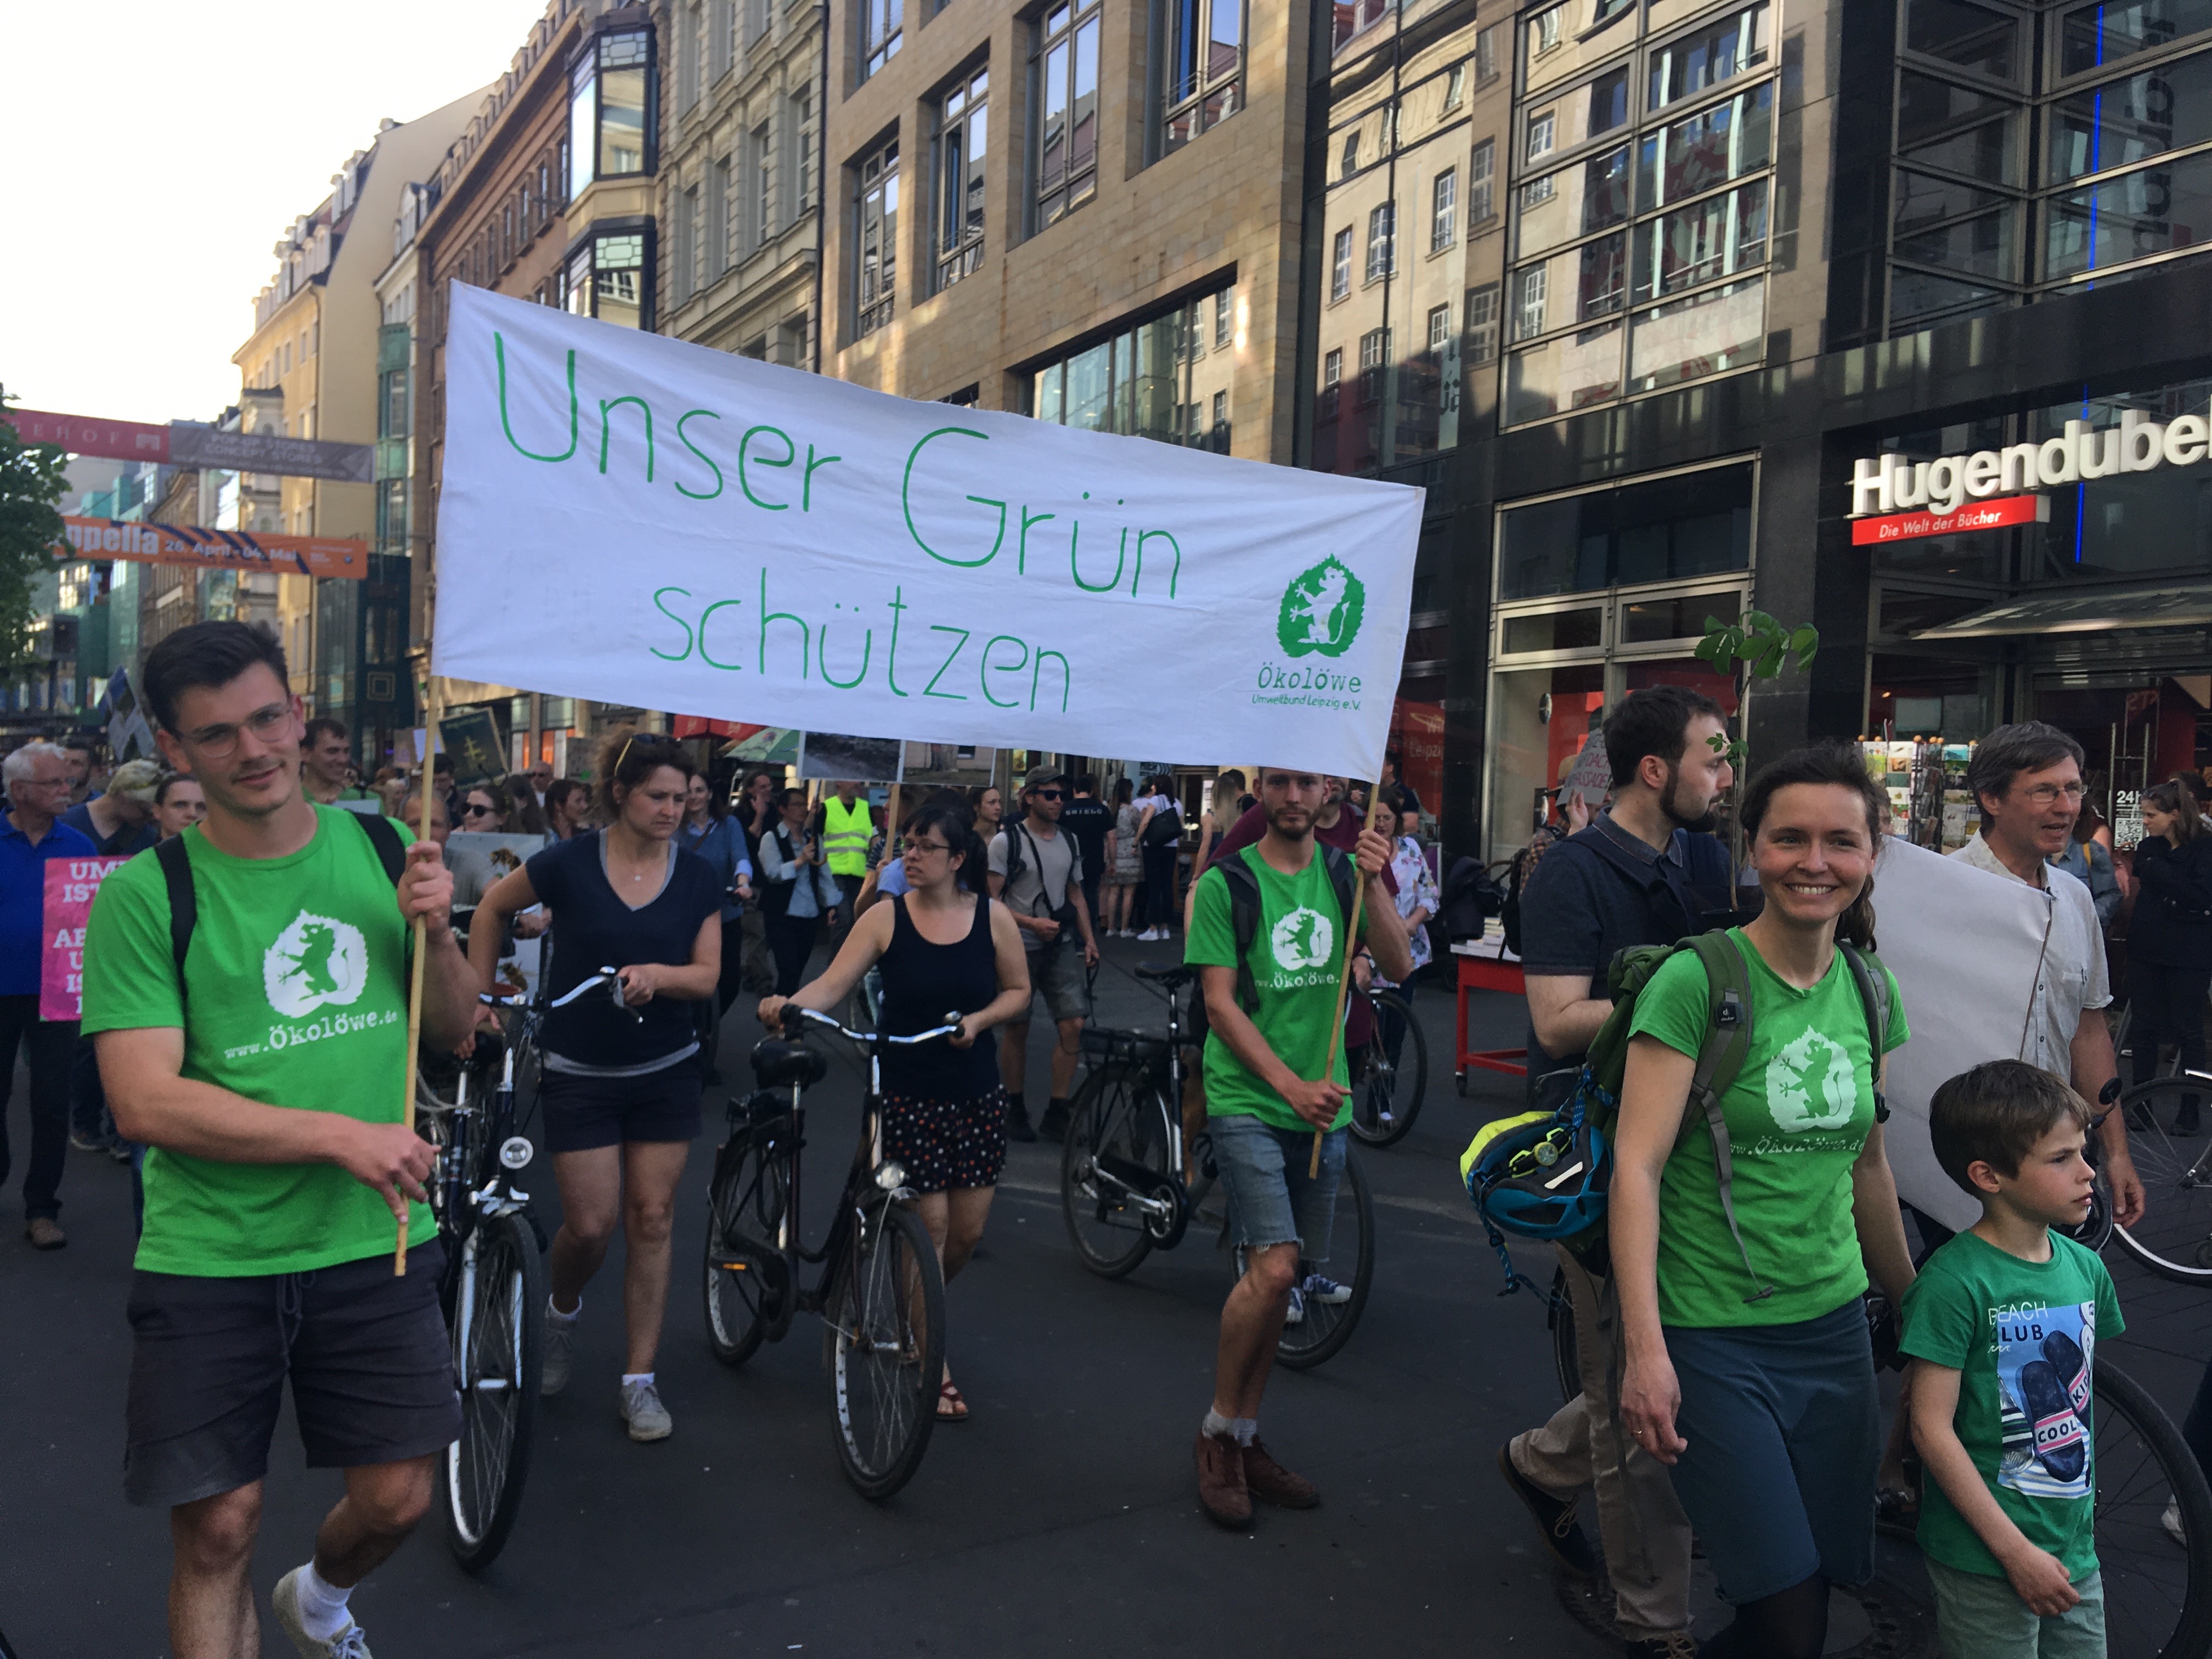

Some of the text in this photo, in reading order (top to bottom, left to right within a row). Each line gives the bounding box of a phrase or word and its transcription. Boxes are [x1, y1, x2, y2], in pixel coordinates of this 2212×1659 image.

[494, 332, 1181, 599] Unser Grün
[1852, 395, 2212, 516] Hugendube
[53, 524, 159, 555] ppella
[1879, 510, 2002, 538] Die Welt der Bücher
[648, 568, 1071, 713] schützen
[1257, 662, 1362, 693] Ökolöwe
[1251, 693, 1361, 711] Umweltbund Leipzig e.V.
[70, 860, 127, 881] UM
[224, 1010, 398, 1059] www.Ökolöwe.de
[1988, 1300, 2049, 1325] BEACH
[2038, 1422, 2078, 1443] COOL
